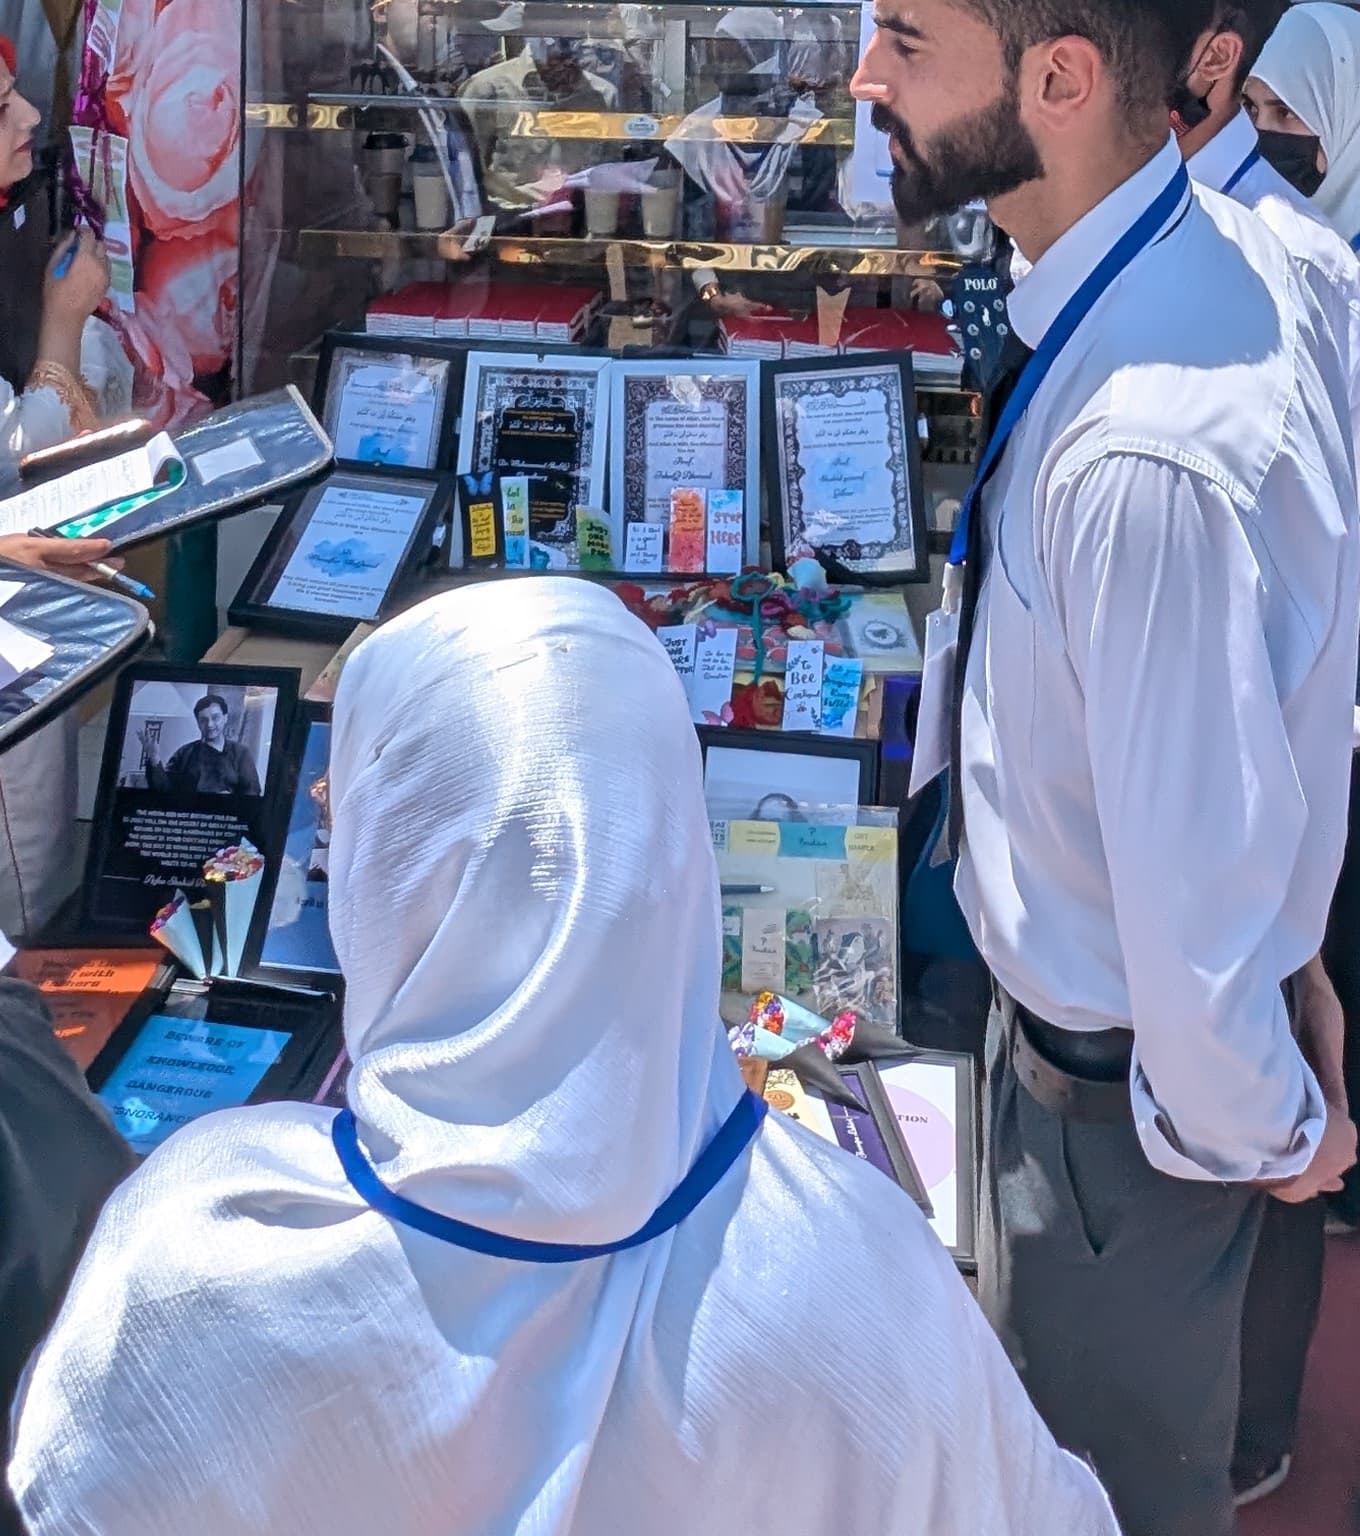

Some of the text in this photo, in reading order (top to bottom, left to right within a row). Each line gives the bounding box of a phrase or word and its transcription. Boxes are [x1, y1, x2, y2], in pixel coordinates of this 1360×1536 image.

[964, 277, 998, 291] POLO
[714, 511, 741, 524] STOP
[664, 638, 689, 647] JUST
[790, 671, 817, 685] Bee
[164, 1029, 225, 1047] BEWARE
[896, 1114, 929, 1124] TION
